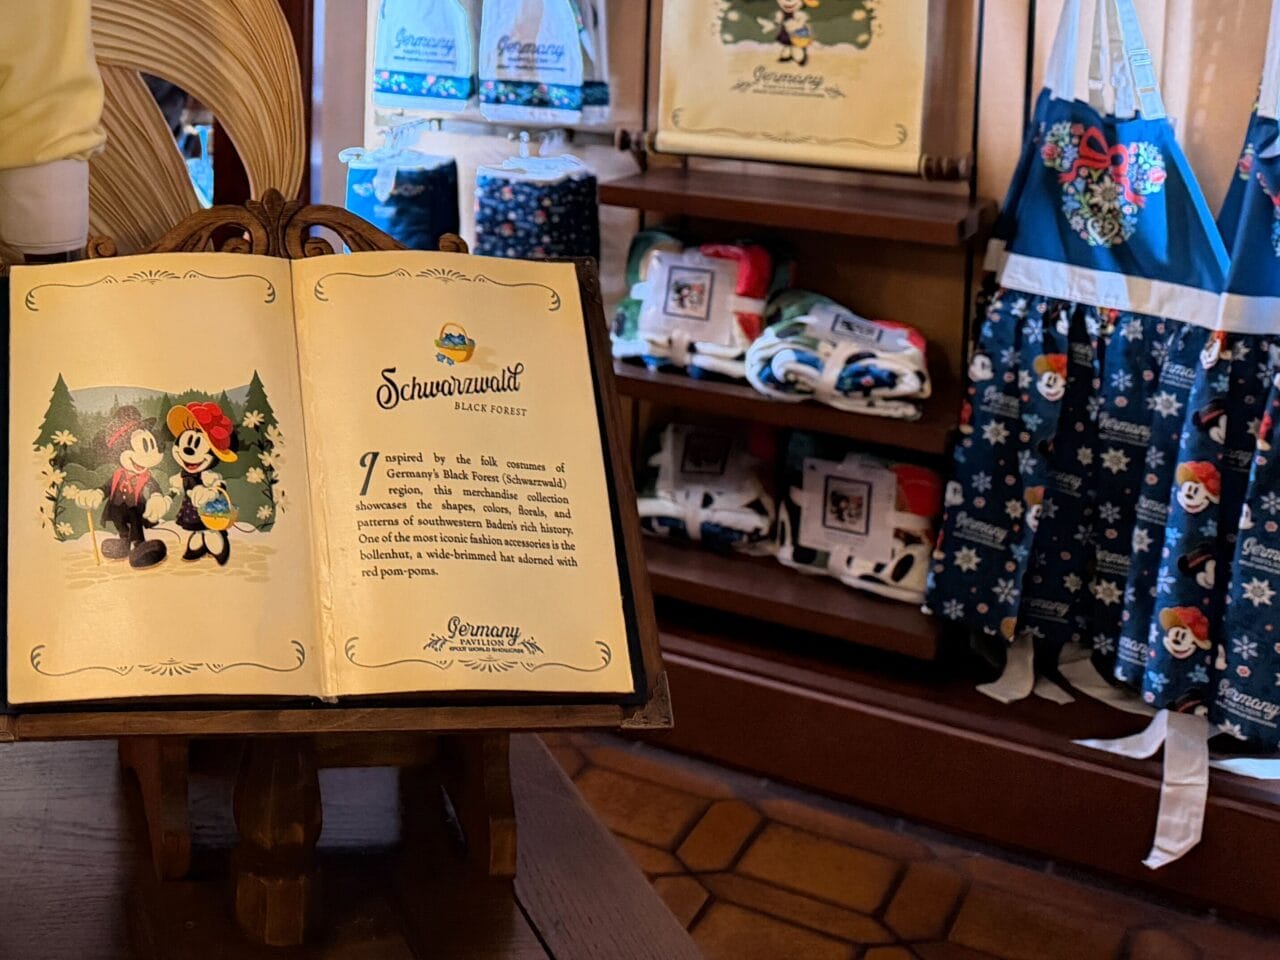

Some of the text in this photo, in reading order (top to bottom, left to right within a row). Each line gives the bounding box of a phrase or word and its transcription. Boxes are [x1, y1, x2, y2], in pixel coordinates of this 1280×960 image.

[396, 26, 456, 57] Germany
[497, 35, 564, 62] Germany
[753, 66, 823, 90] Germany
[376, 362, 524, 410] Schwarzwald
[454, 401, 527, 417] BLACK FOREST
[433, 452, 445, 465] by
[456, 453, 471, 464] the
[480, 455, 498, 467] folk
[506, 460, 546, 471] costumes
[555, 462, 565, 473] of
[386, 468, 567, 489] Germany's Black Forest (Schwarzwald)
[388, 484, 569, 504] region, this merchandise collection
[356, 498, 572, 519] showcases the shapes, colors, florals, and
[357, 514, 574, 537] patterns of southwestern Baden's rich history.
[358, 531, 576, 551] One of the most iconic fashion accessories is the
[359, 548, 578, 567] bollenhut, a wide-brimmed hat adorned with
[362, 565, 439, 580] red pom-poms.
[447, 615, 521, 646] Germany
[460, 639, 504, 647] PAVILION
[1218, 678, 1280, 721] Germany
